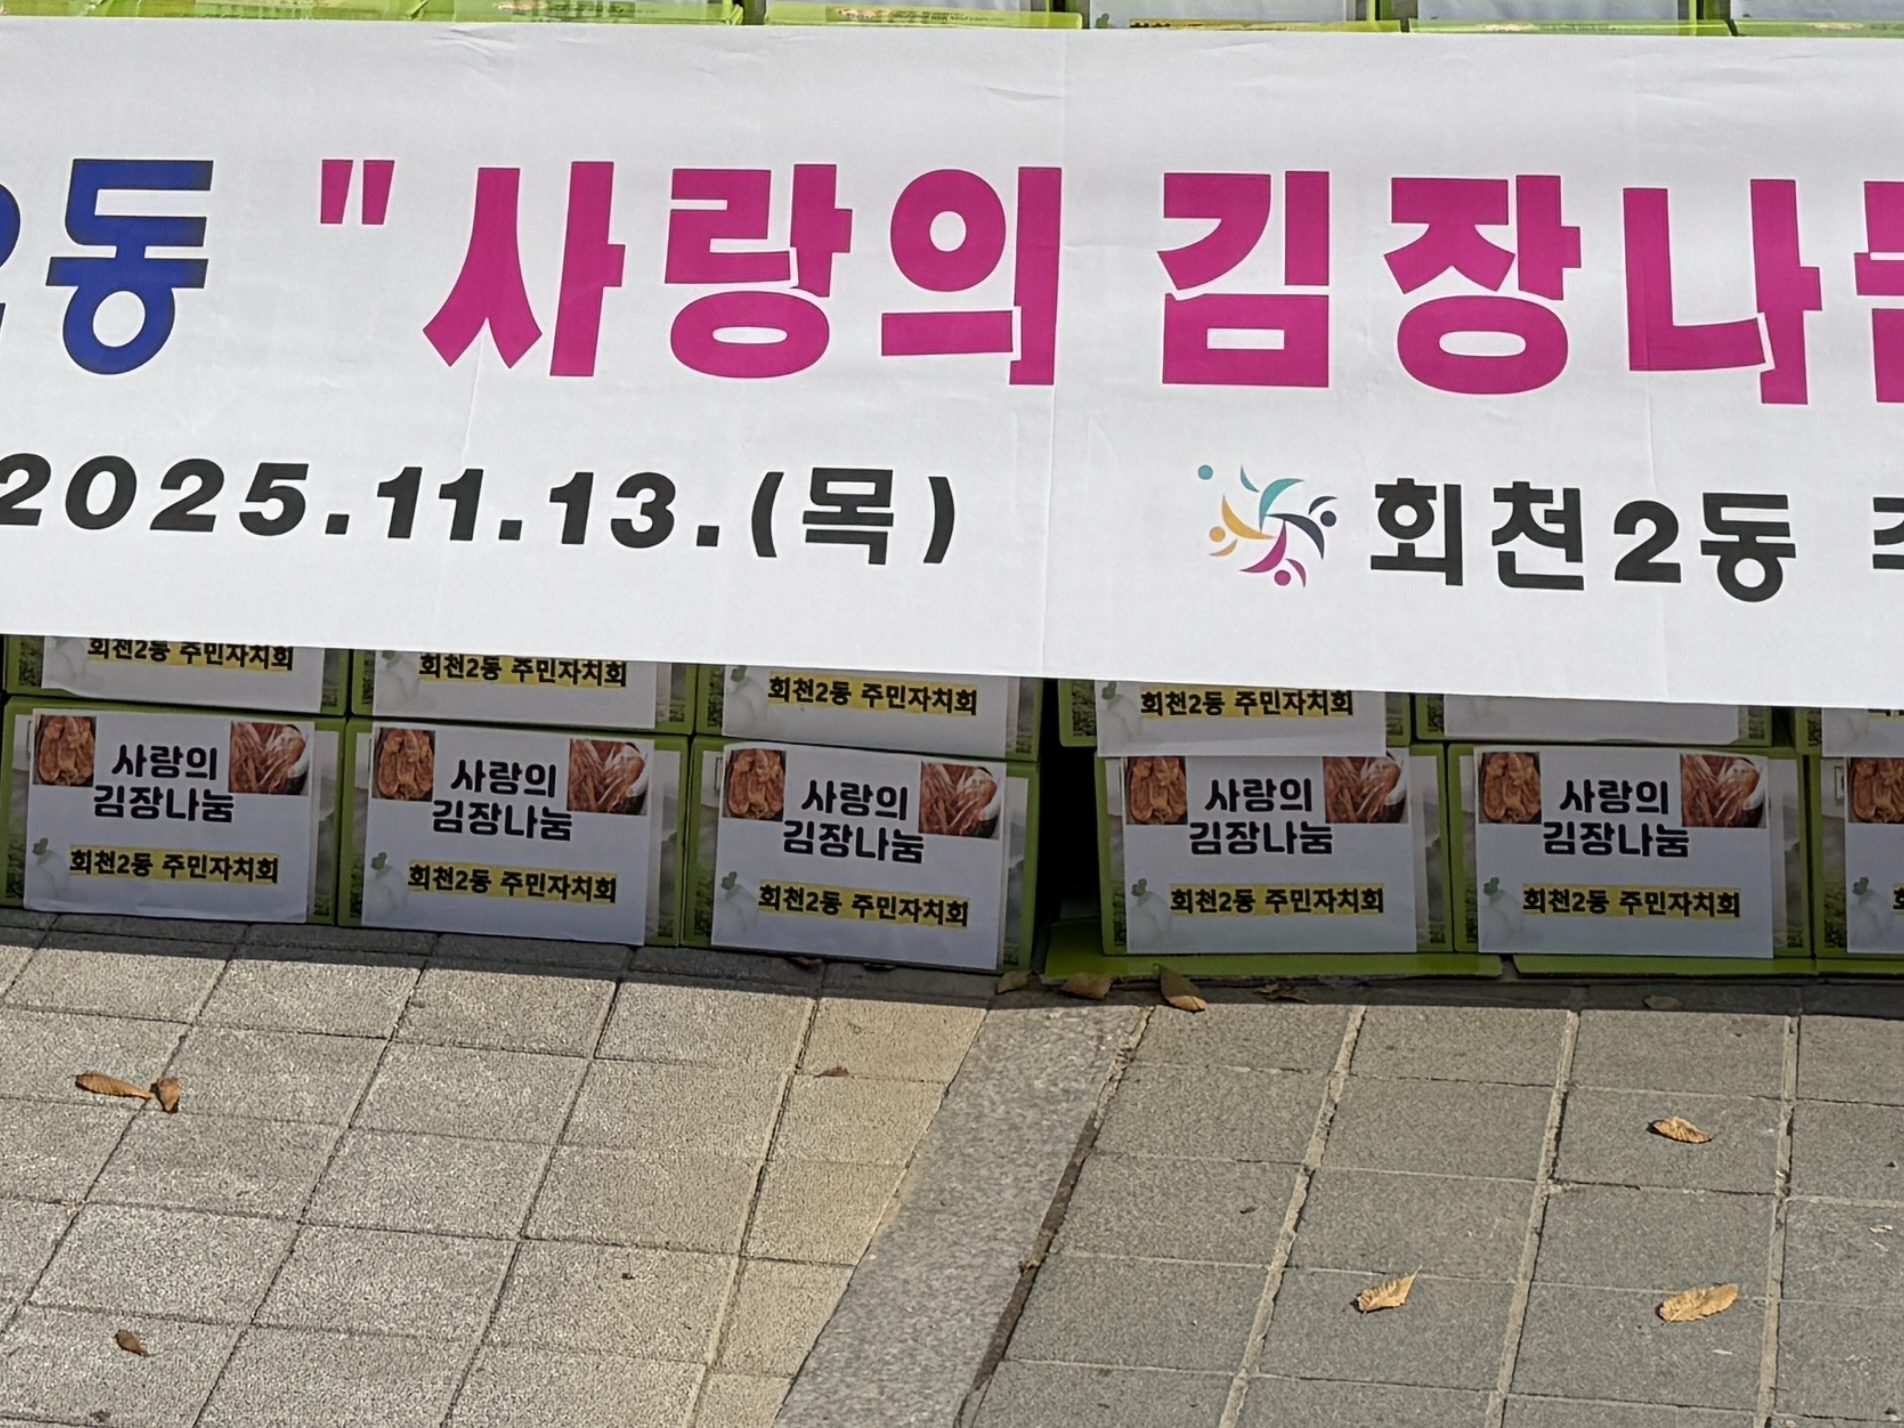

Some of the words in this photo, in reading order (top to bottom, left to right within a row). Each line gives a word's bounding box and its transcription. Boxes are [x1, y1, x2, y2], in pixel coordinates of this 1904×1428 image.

[320, 159, 1062, 385] "사랑의
[1371, 478, 1796, 602] 회천2동
[768, 677, 851, 705] 회천2동
[861, 683, 977, 715] 주민자치회
[1141, 691, 1225, 716] 회천2동
[1235, 690, 1353, 716] 주민자치회
[451, 760, 556, 798] 사랑의
[1205, 778, 1312, 812] 사랑의
[801, 780, 907, 820] 사랑의
[433, 800, 572, 841] 김장나눔
[1190, 821, 1332, 854] 김장나눔
[784, 820, 924, 864] 김장나눔
[408, 865, 491, 893] 회천2동
[500, 871, 616, 903] 주민자치회
[1171, 889, 1255, 914] 회천2동
[1265, 888, 1383, 913] 주민자치회
[758, 885, 842, 915] 회천2동
[851, 894, 968, 923] 주민자치회
